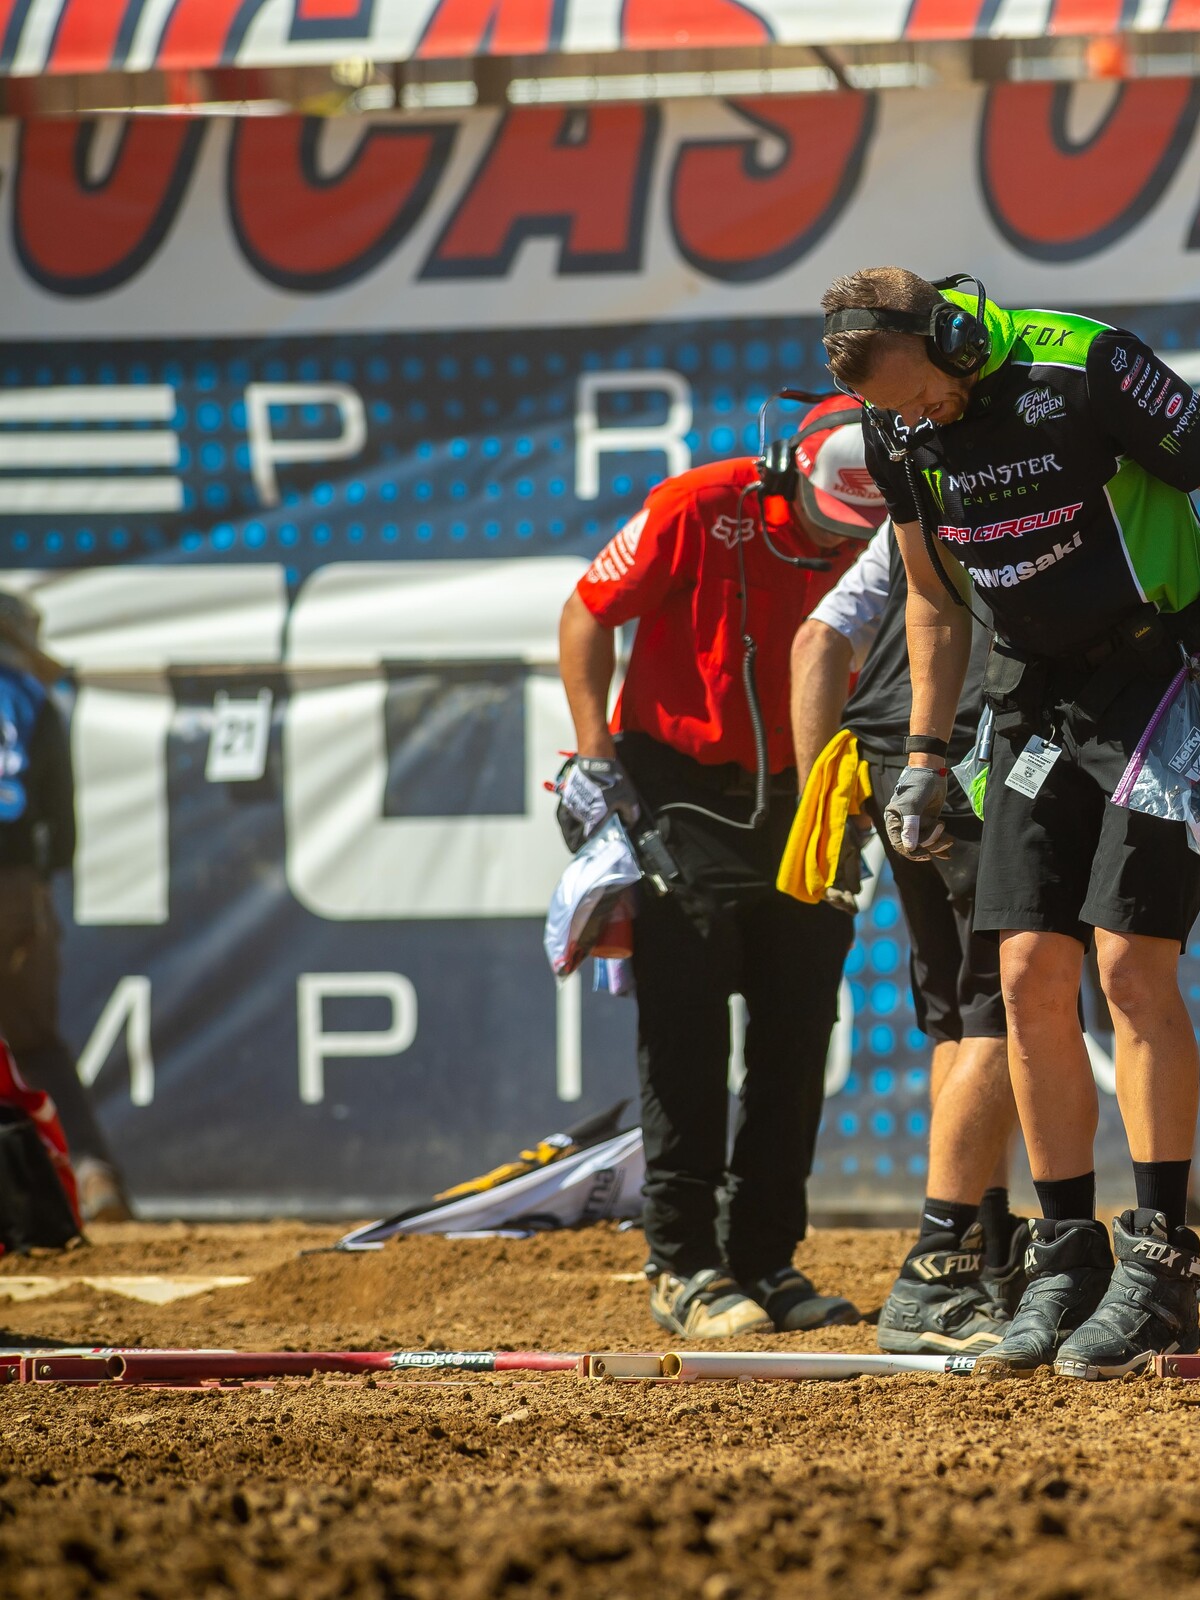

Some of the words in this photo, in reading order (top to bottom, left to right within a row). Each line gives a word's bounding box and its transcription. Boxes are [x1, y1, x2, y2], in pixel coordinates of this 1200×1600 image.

[1019, 324, 1075, 347] FOX
[1132, 362, 1151, 398] DUNLOP
[1144, 369, 1161, 401] SCOTT
[1015, 388, 1050, 414] TEAM
[1025, 396, 1063, 425] GREEN
[1167, 396, 1182, 415] BELL
[948, 453, 1063, 495] MONSTER
[963, 482, 1041, 507] ENERGY
[937, 524, 973, 545] PRO
[972, 501, 1084, 543] CIRCUIT
[943, 1254, 982, 1275] FOX
[1024, 1247, 1038, 1270] OX
[1132, 1239, 1181, 1268] FOX
[397, 1352, 494, 1366] Hangtown
